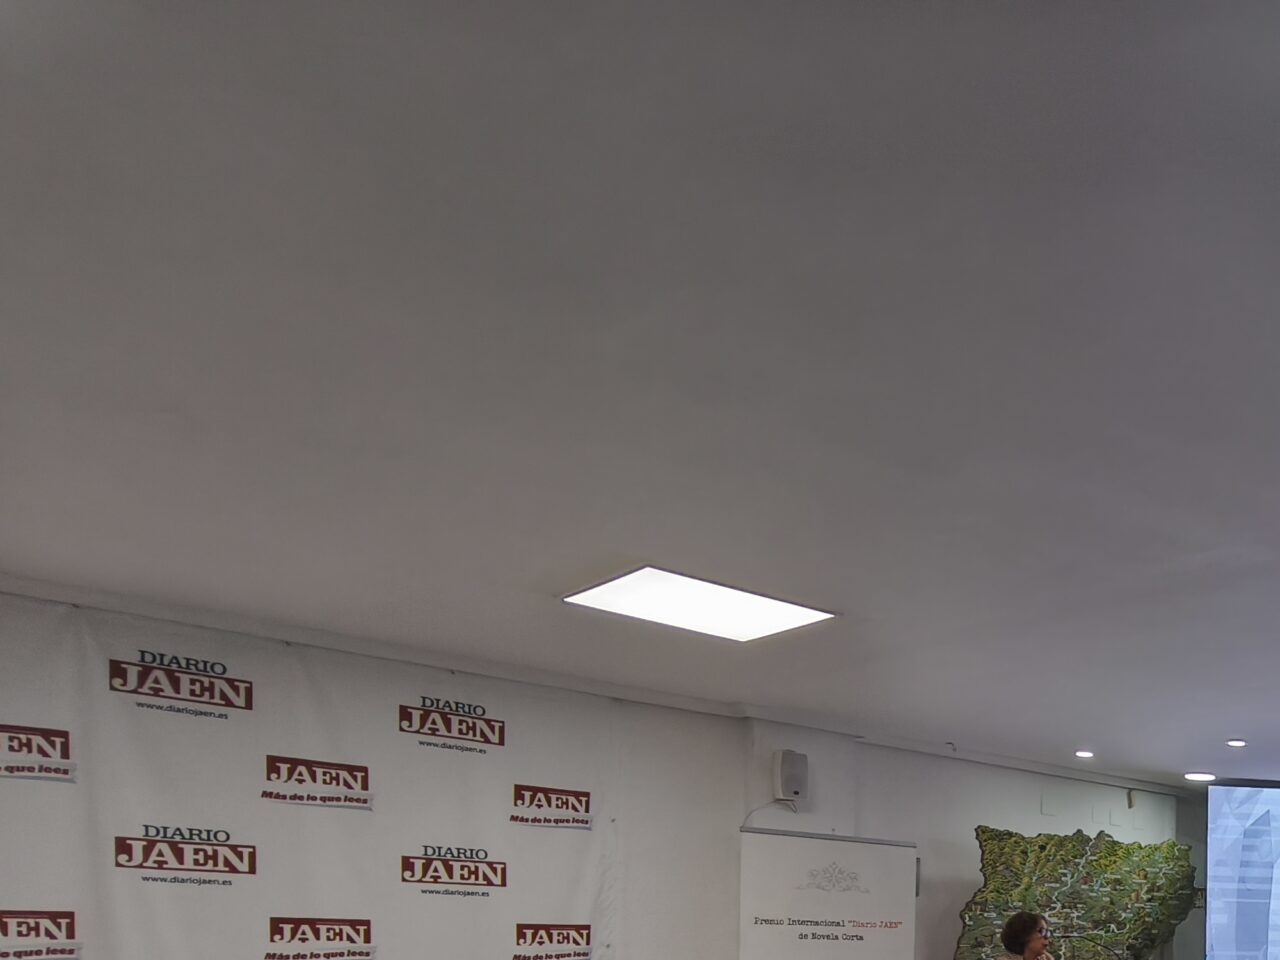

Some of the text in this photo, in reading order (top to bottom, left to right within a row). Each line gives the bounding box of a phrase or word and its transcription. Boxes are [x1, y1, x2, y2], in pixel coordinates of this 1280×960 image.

[138, 650, 227, 675] DIARIO
[111, 664, 250, 707] JAEN
[136, 702, 228, 719] www.diariojaen.es
[420, 696, 486, 716] DIARIO
[400, 708, 503, 744] JAEN
[0, 732, 65, 760] EN
[418, 740, 487, 754] www.diariojaen.es
[270, 763, 365, 790] JAEN
[261, 791, 287, 800] Más
[344, 796, 368, 804] lees
[516, 791, 588, 813] JAEN
[510, 815, 529, 823] Más
[142, 824, 230, 842] DIARIO
[117, 840, 253, 872] JAEN
[422, 845, 488, 859] DIARIO
[403, 858, 505, 885] JAEN
[141, 875, 232, 886] www.diariojaen.es
[421, 888, 490, 897] www.diariojaen.es
[0, 918, 71, 940] EN
[754, 917, 784, 925] Premio
[787, 918, 846, 927] Internacional
[848, 919, 877, 928] "Diario
[273, 924, 368, 944] JAEN
[518, 929, 589, 946] JAEN
[811, 933, 839, 941] Novela
[841, 933, 864, 941] Corta
[13, 949, 43, 959] que
[45, 947, 75, 955] lees
[264, 952, 290, 960] Más
[292, 952, 308, 960] de
[323, 950, 345, 959] que
[347, 949, 371, 957] lees
